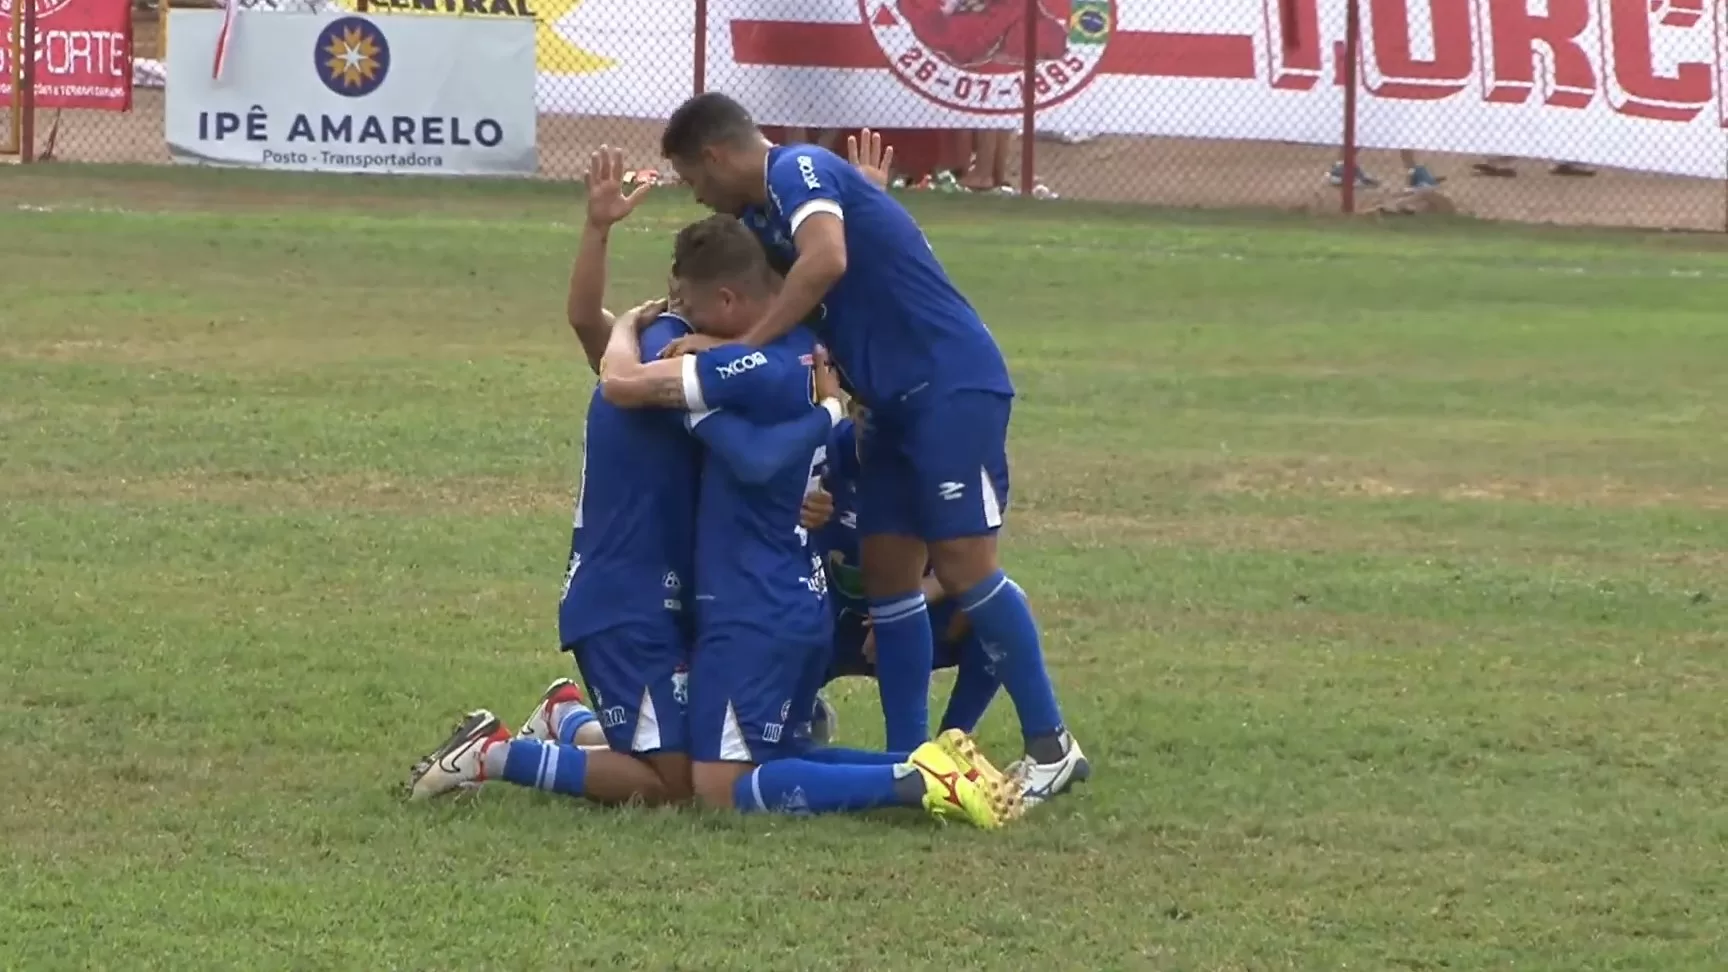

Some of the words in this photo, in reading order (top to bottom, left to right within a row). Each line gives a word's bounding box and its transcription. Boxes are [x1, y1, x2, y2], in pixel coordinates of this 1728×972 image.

[198, 104, 269, 141] IPÊ
[286, 113, 504, 148] AMARELO
[262, 149, 308, 165] Posto
[322, 150, 443, 169] Transportadora
